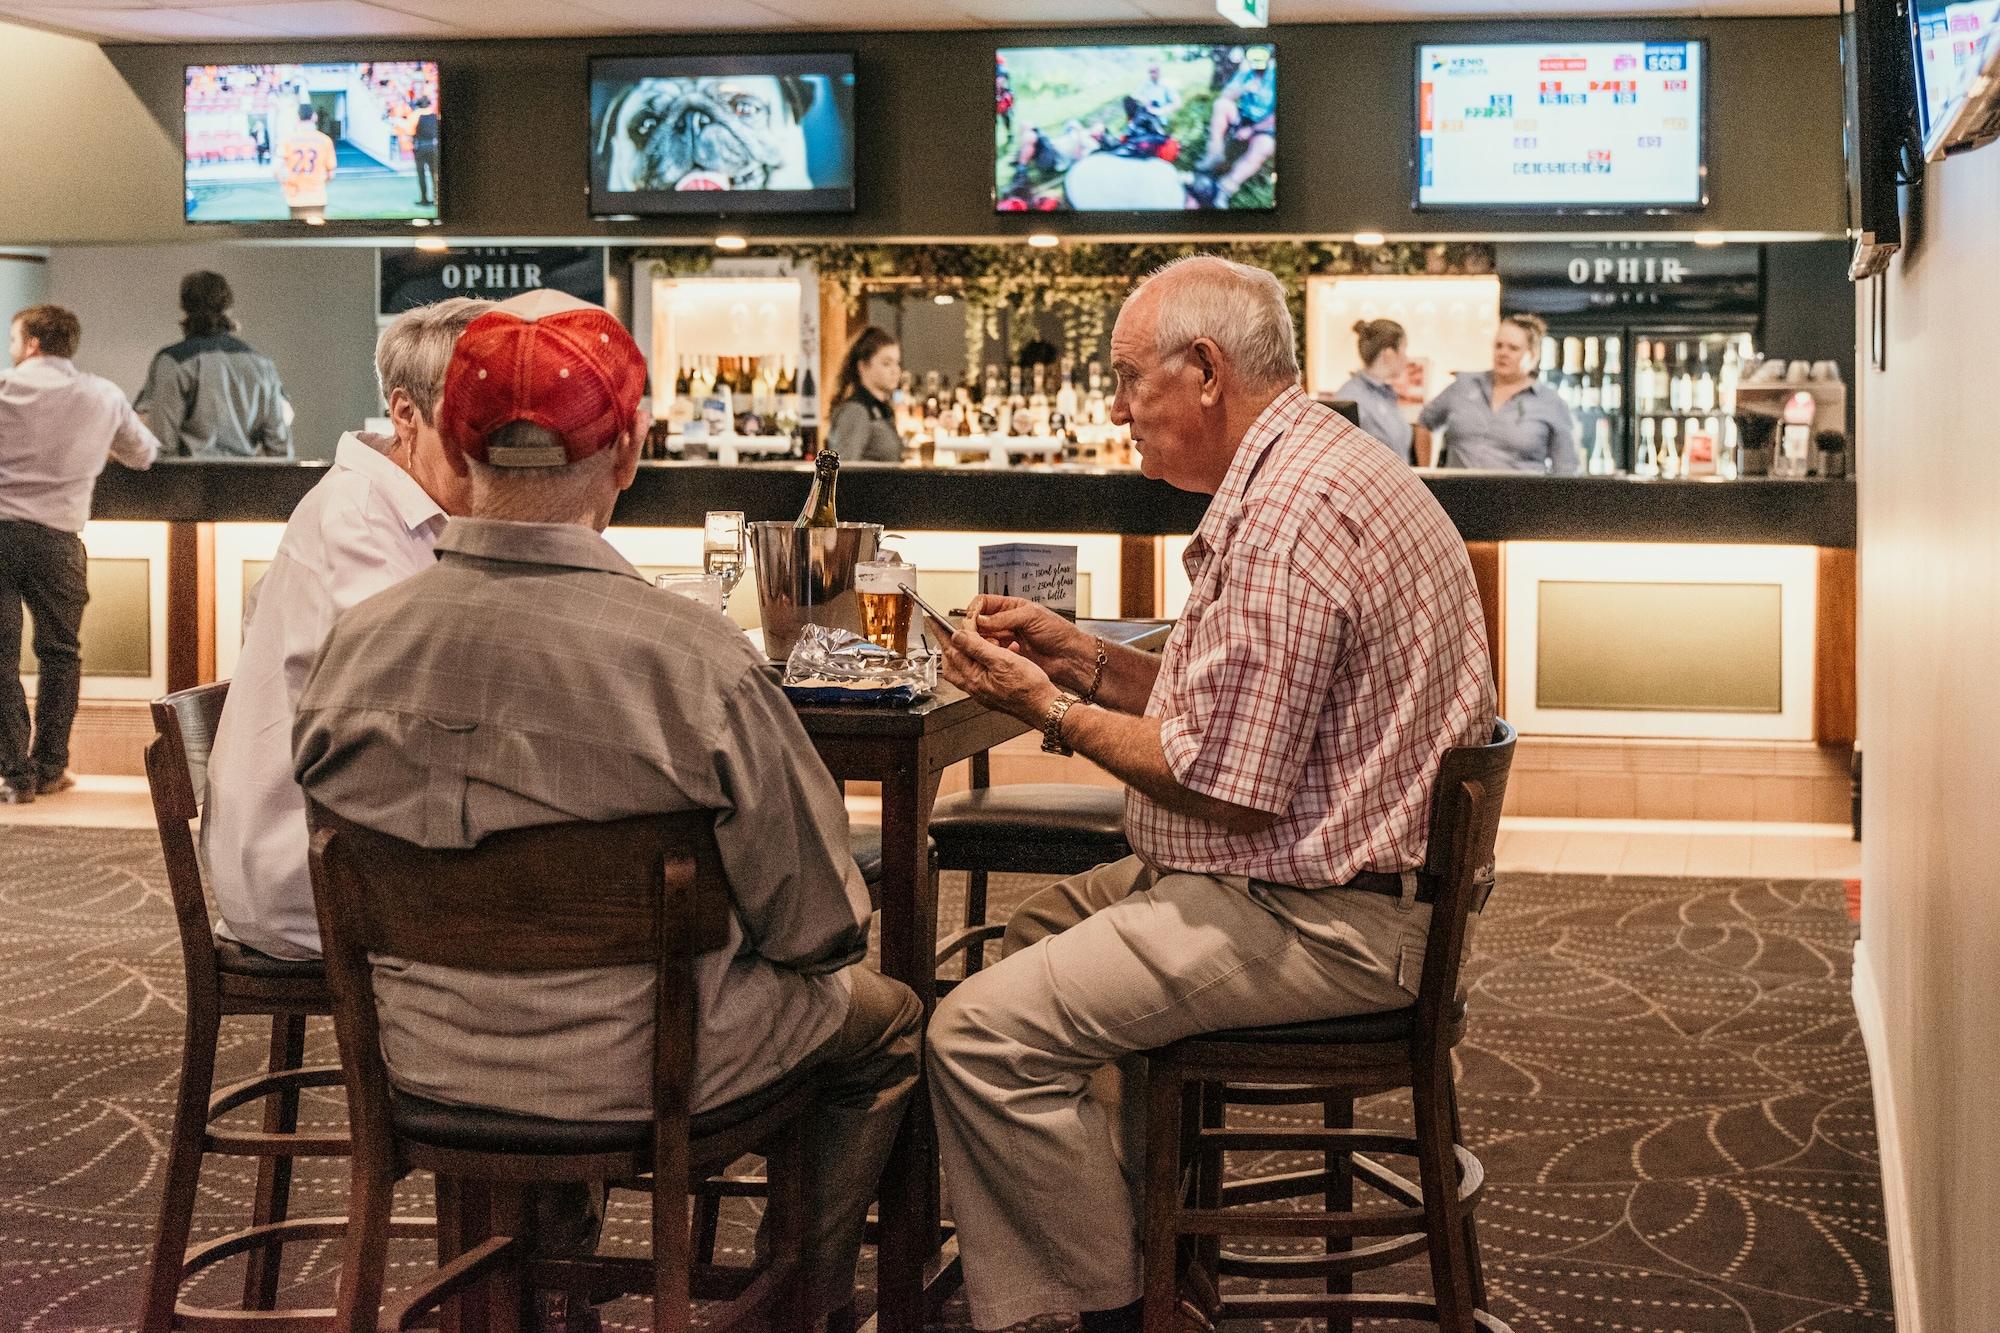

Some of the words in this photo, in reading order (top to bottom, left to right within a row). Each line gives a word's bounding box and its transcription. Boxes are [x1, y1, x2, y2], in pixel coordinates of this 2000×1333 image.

[292, 148, 318, 175] 23
[441, 263, 543, 289] OPHIR
[1568, 257, 1683, 284] OPHIR
[1053, 562, 1071, 577] glass
[1056, 575, 1074, 589] glass
[1047, 587, 1066, 601] bottle
